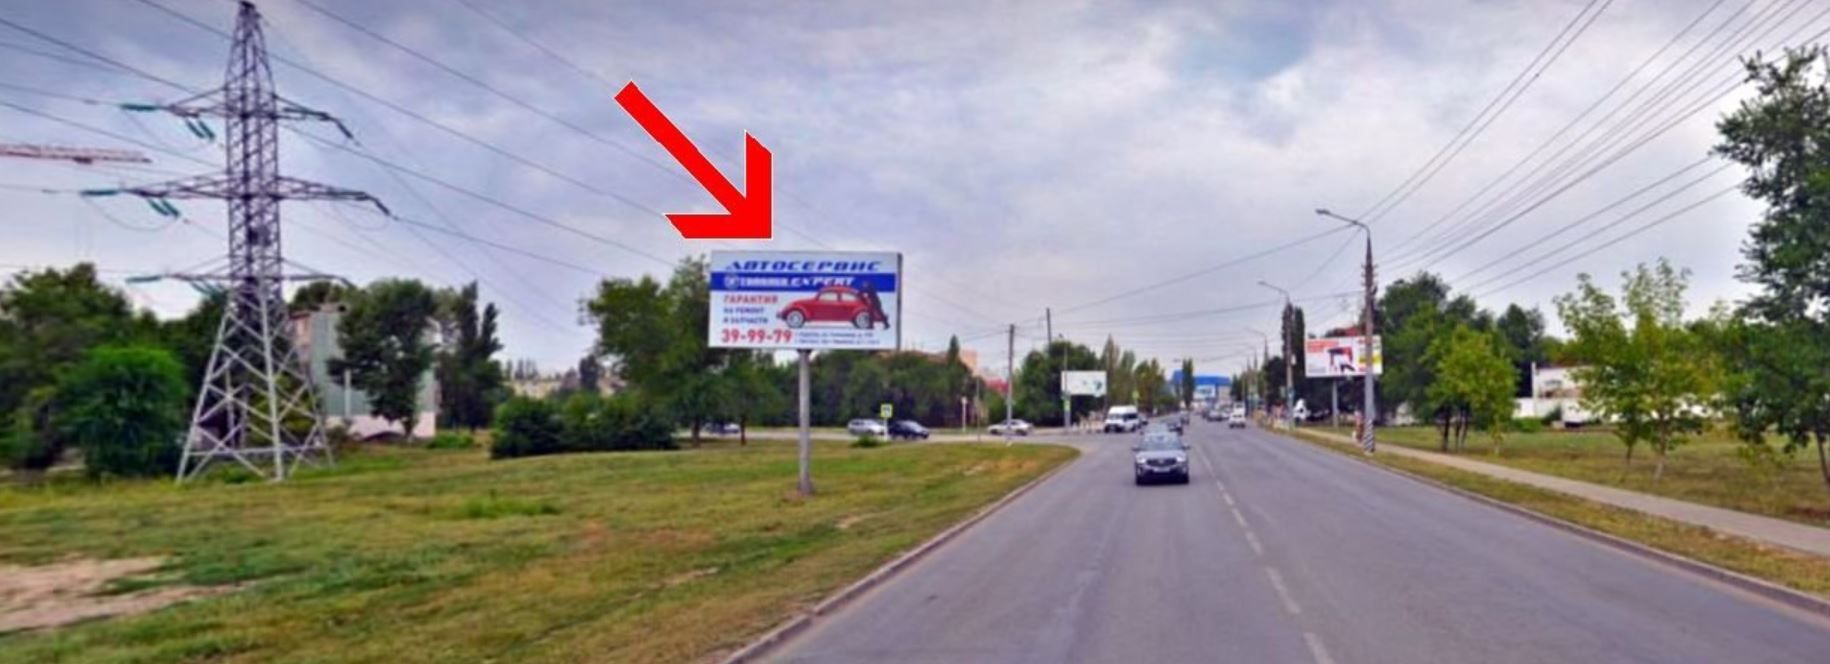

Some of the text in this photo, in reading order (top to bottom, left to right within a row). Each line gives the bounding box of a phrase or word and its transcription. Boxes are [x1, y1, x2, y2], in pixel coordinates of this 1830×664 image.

[726, 260, 882, 272] АВТОСЕРВИС
[723, 295, 778, 304] ГАРАНТИЯ
[721, 328, 792, 344] 39-99-79
